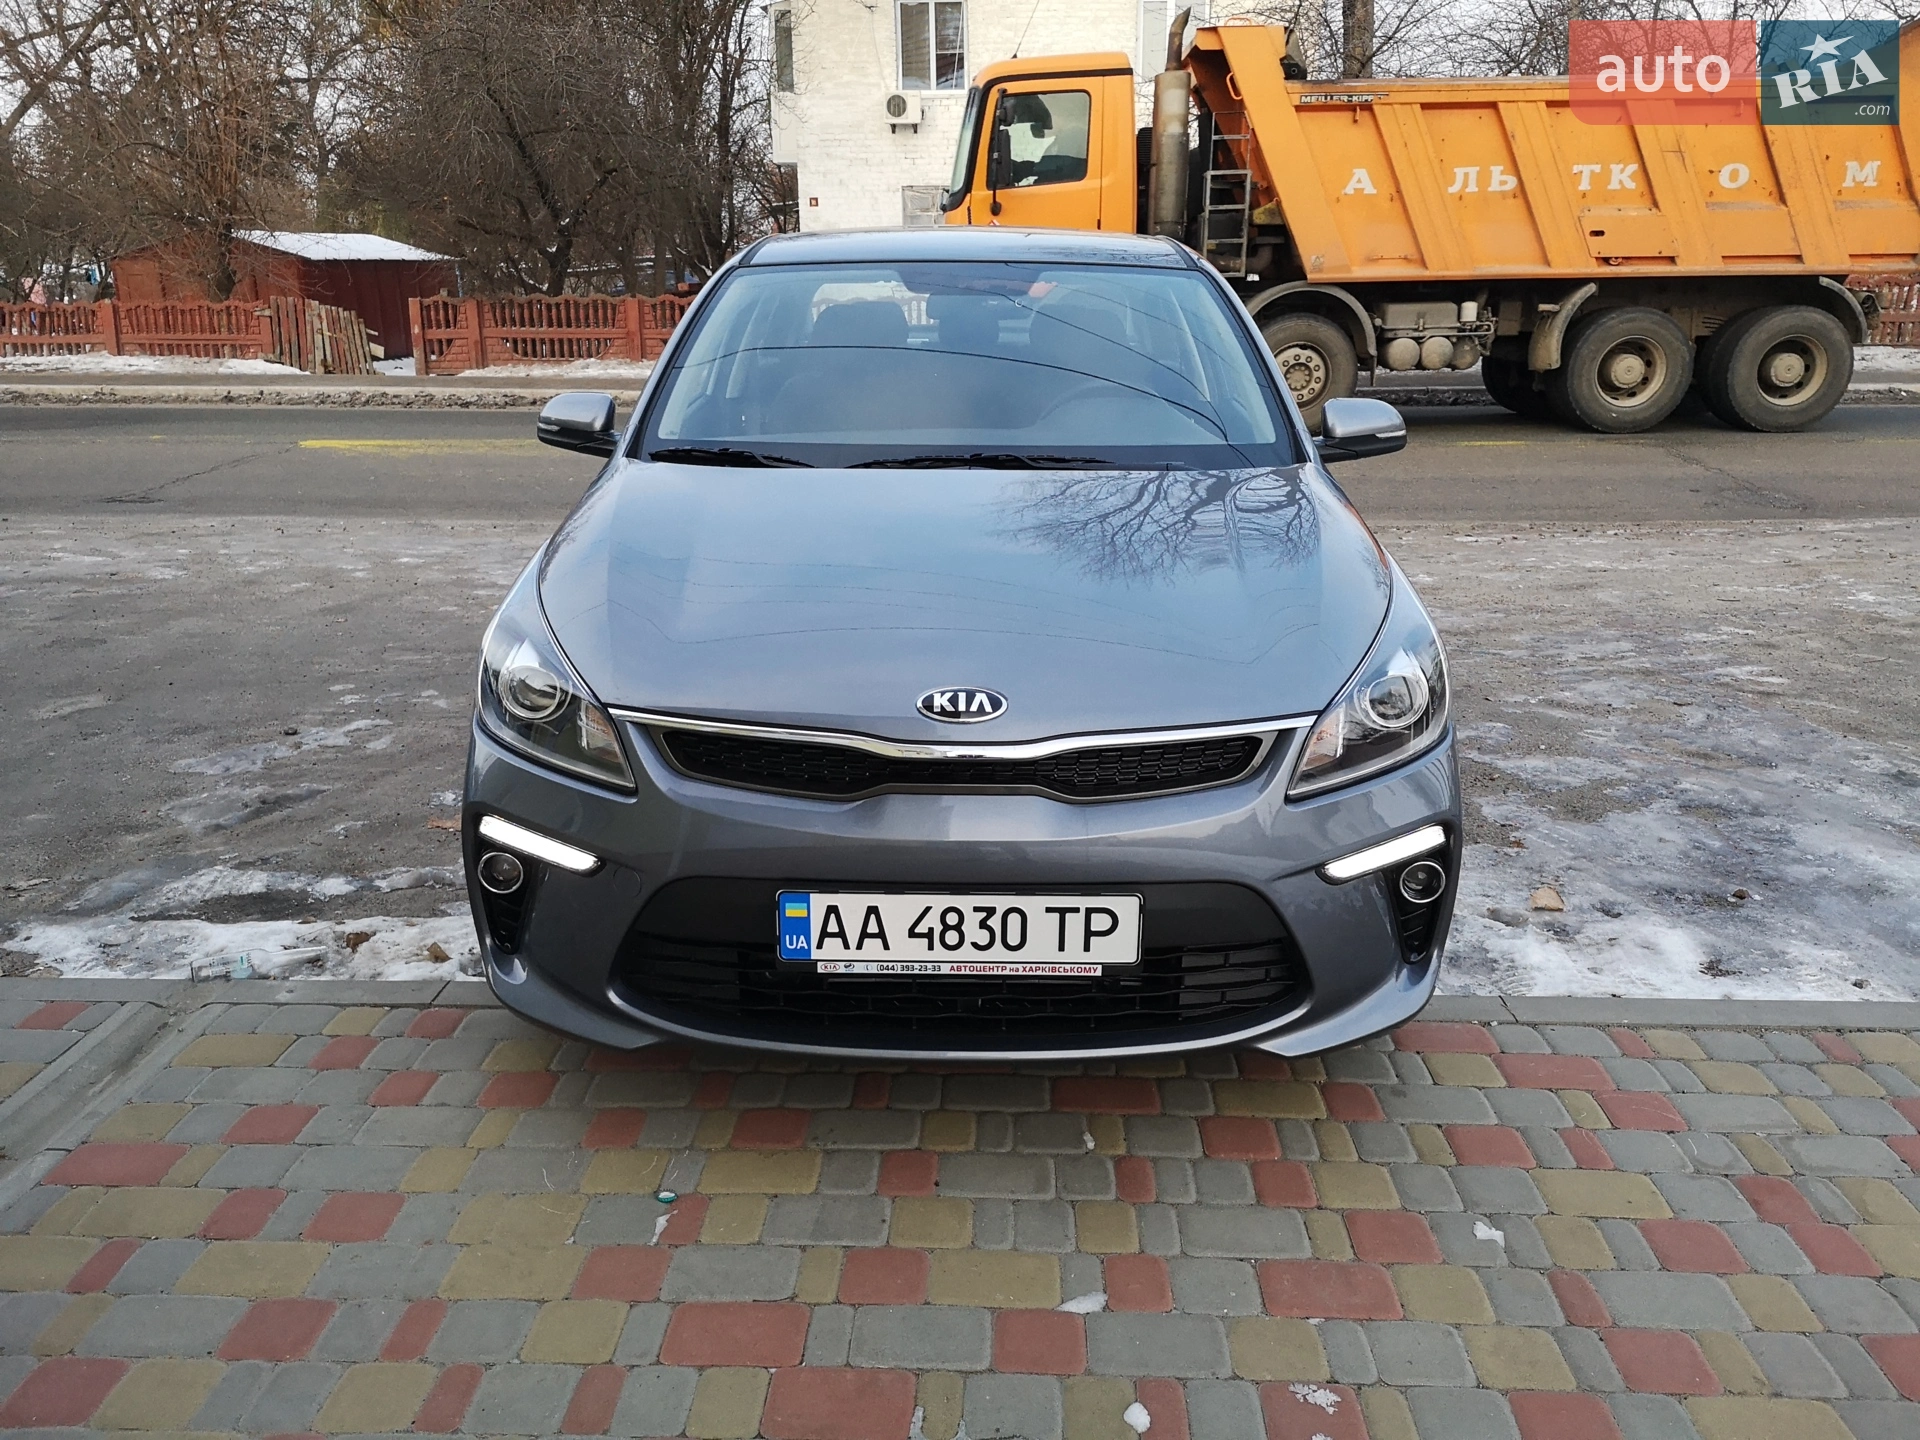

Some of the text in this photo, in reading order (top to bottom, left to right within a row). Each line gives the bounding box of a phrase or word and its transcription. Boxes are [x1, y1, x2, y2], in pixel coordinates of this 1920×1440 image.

[933, 692, 993, 712] KIA
[815, 904, 1120, 953] AA 4830 TP
[785, 934, 808, 950] UA
[876, 964, 942, 972] (044) 393-23-33
[949, 965, 1007, 973] АВТОЦЕНТР
[1021, 965, 1099, 974] ХАРКІВСЬКОМУ
